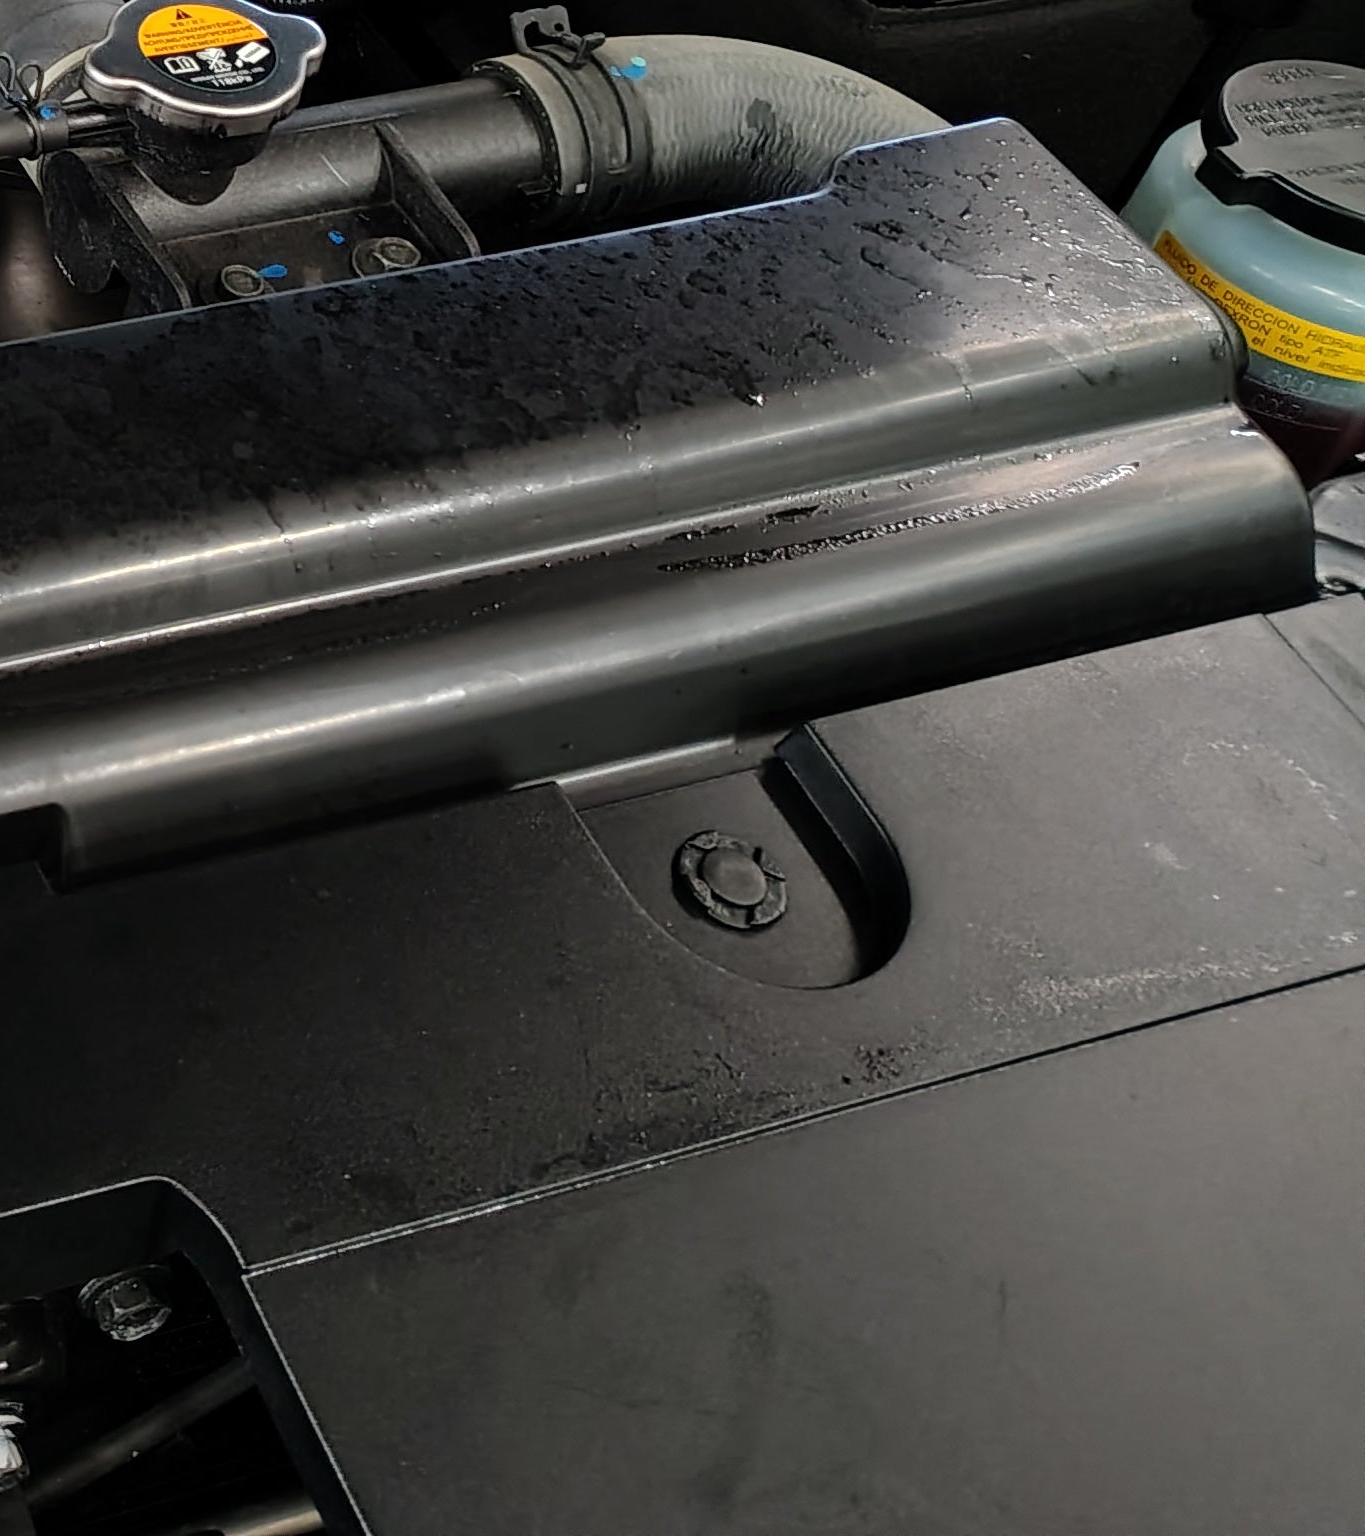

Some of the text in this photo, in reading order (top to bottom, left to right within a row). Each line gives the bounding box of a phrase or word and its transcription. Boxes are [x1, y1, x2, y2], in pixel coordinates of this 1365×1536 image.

[1200, 274, 1219, 292] DE
[1223, 289, 1301, 335] DIRECCION
[1279, 334, 1304, 350] tipo
[1274, 346, 1311, 365] nivel
